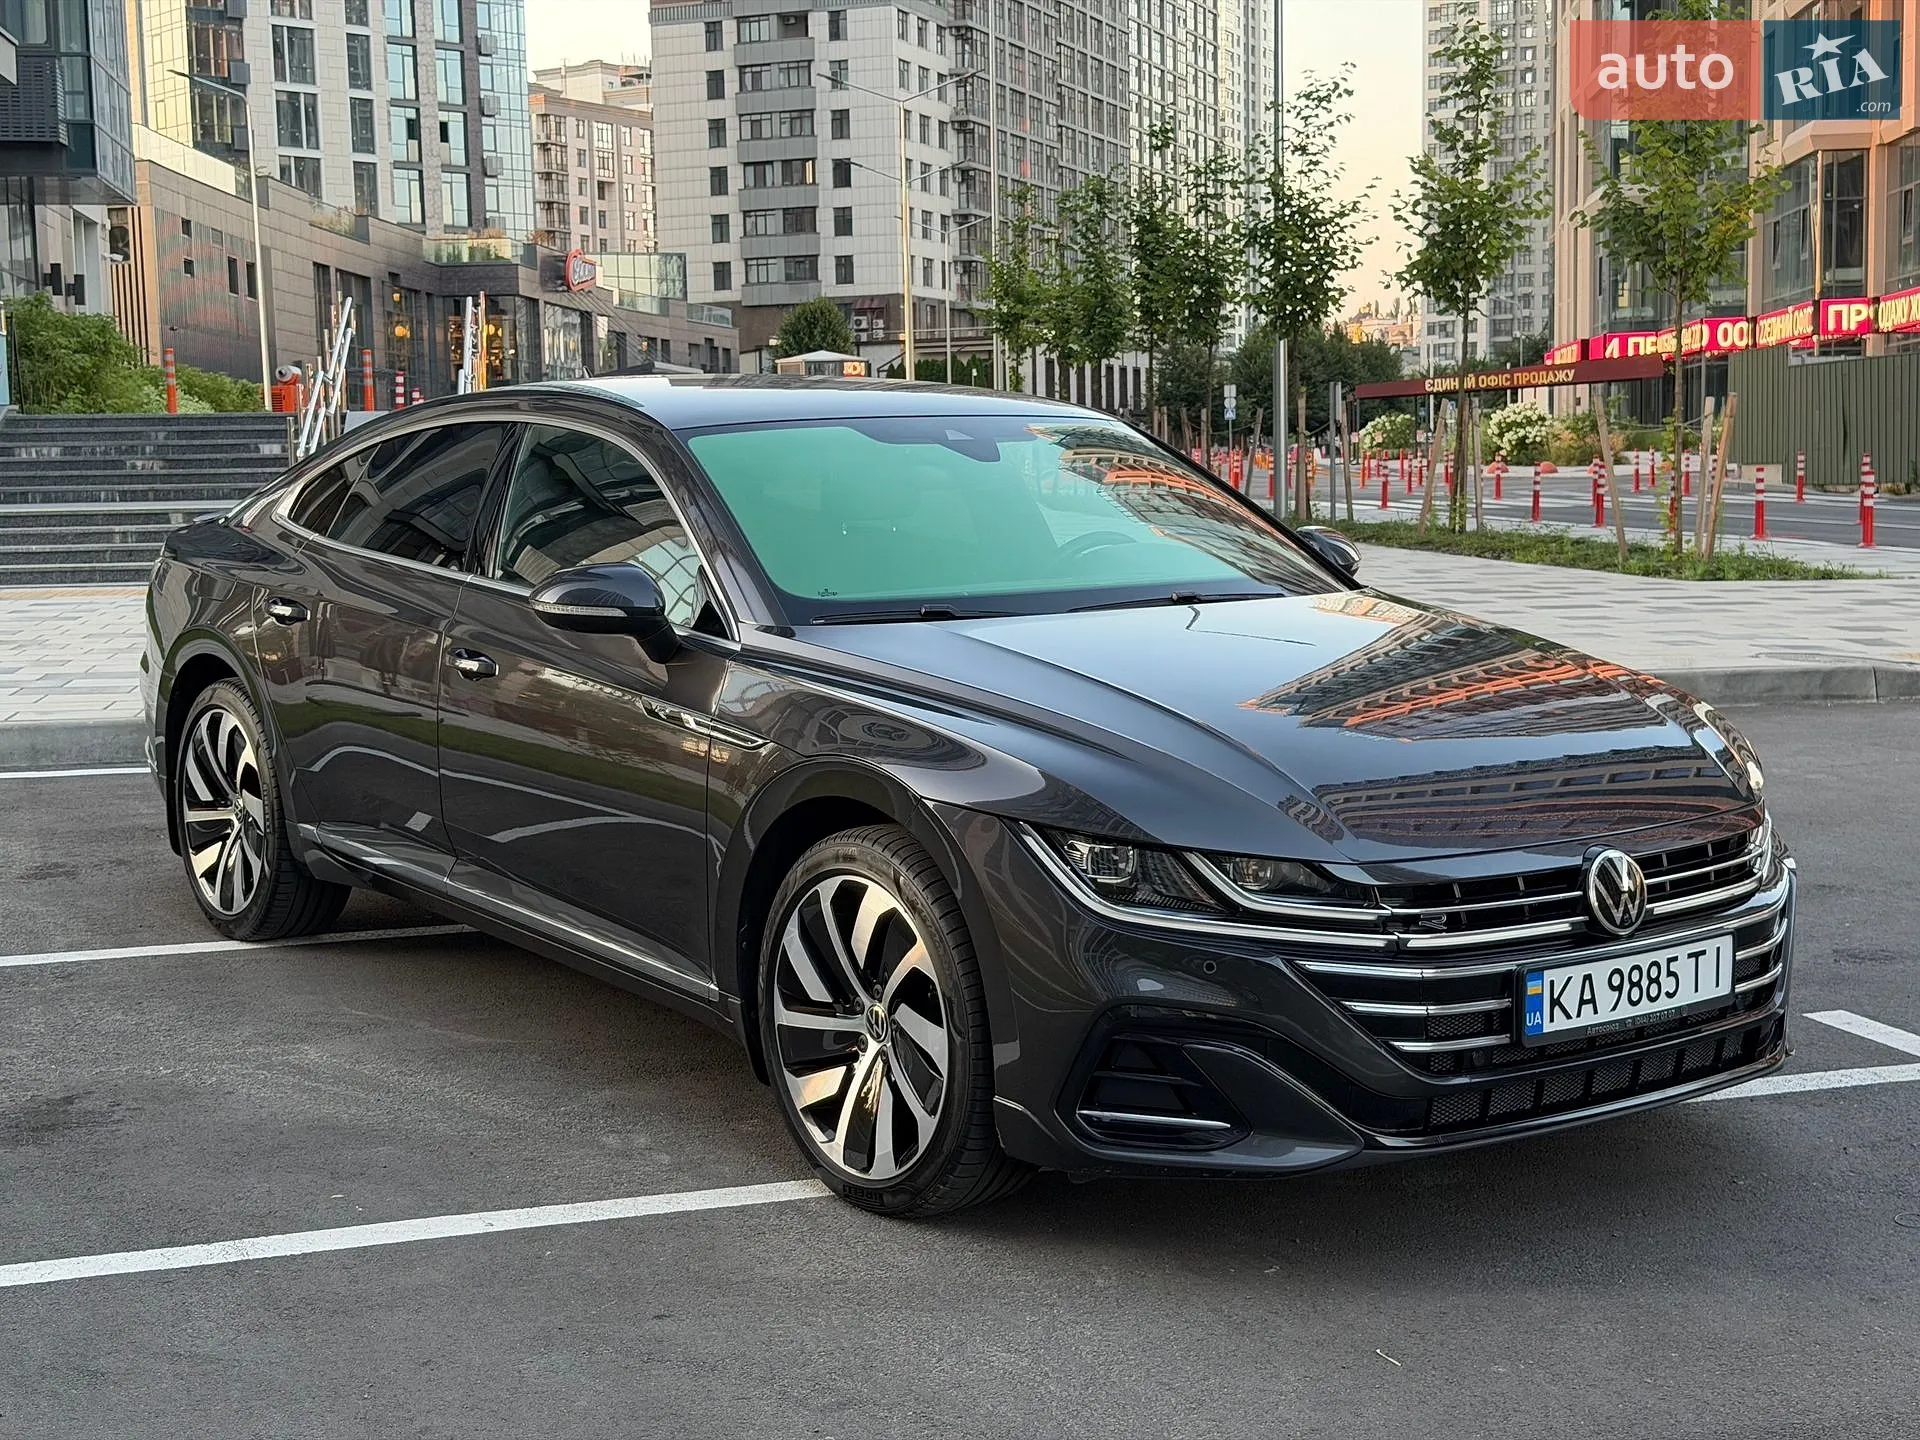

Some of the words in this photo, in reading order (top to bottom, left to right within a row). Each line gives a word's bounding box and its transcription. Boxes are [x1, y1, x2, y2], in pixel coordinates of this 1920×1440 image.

[1478, 373, 1511, 388] ОФІС
[1513, 369, 1575, 385] ПРОДАЖУ
[1549, 972, 1599, 1023] KA
[1607, 955, 1680, 1012] 9885
[1687, 946, 1721, 994] TI
[1526, 1012, 1542, 1027] UA
